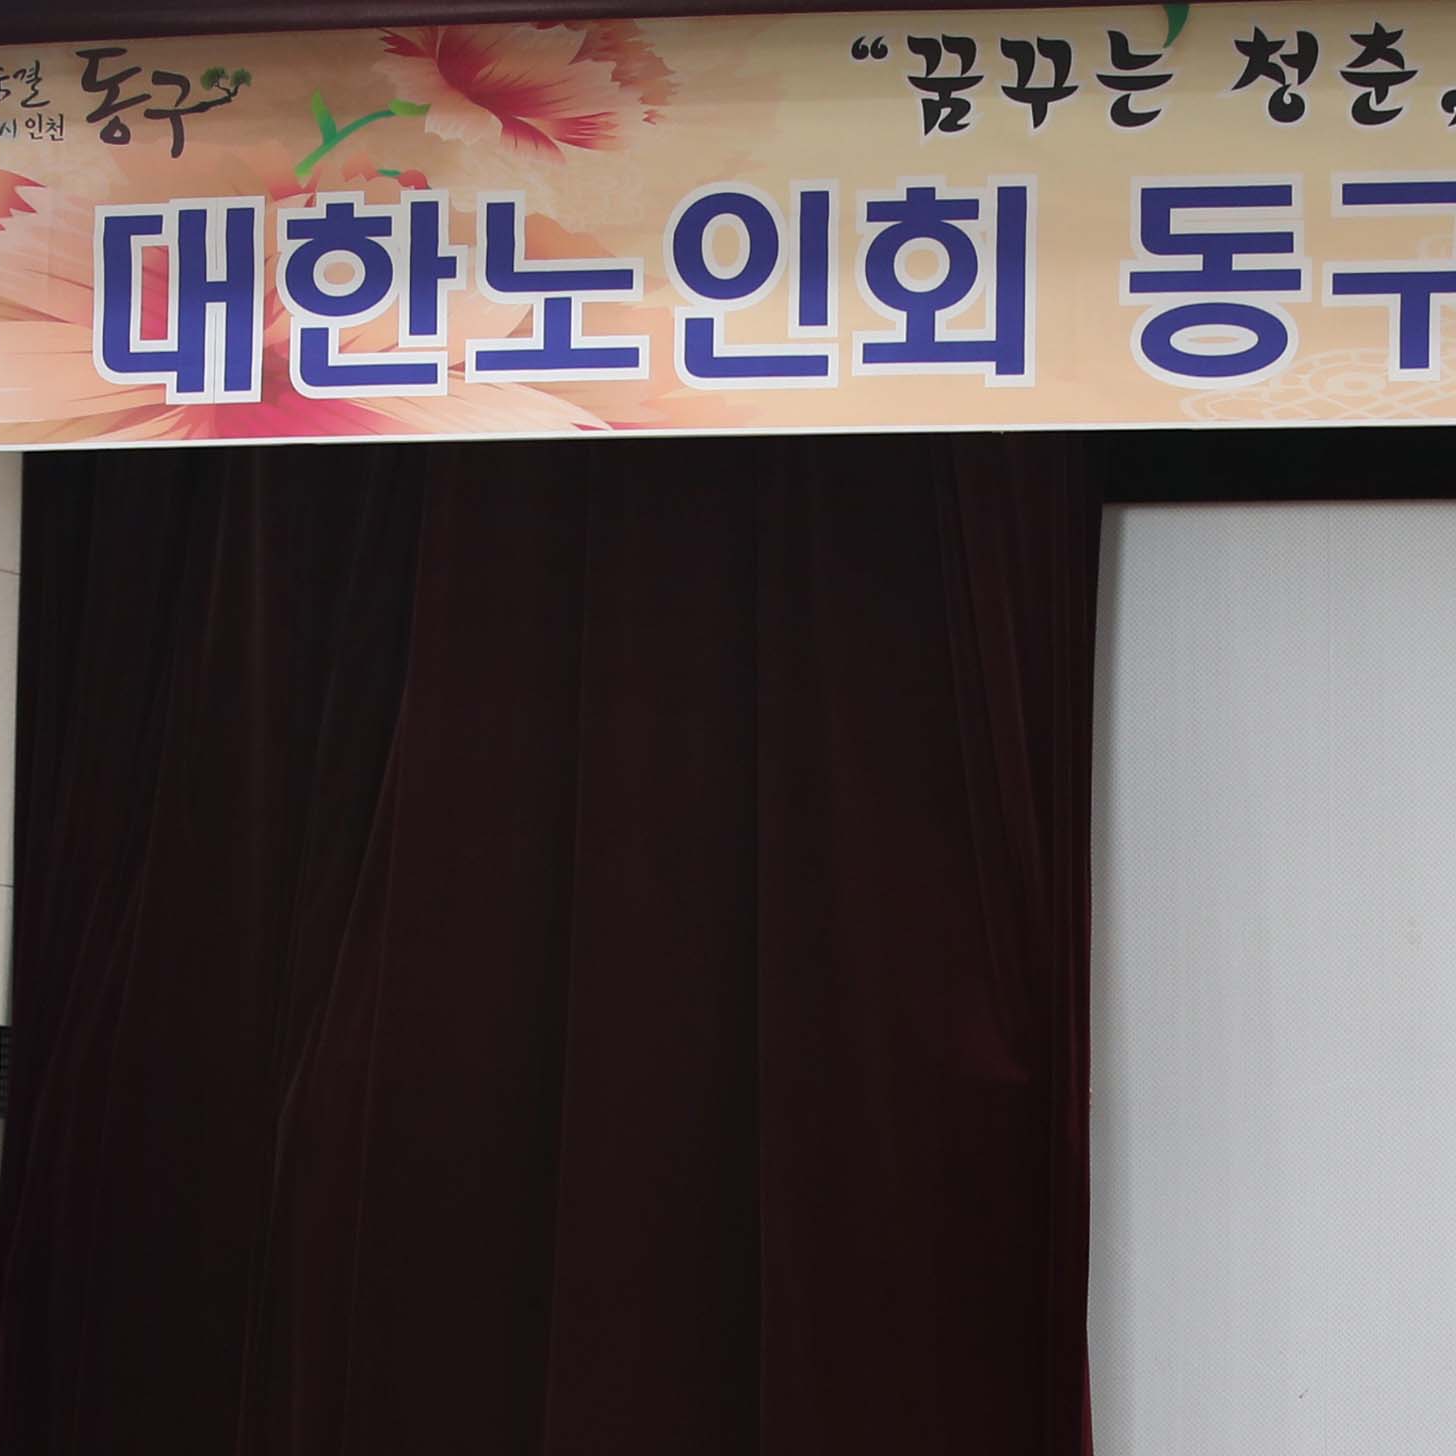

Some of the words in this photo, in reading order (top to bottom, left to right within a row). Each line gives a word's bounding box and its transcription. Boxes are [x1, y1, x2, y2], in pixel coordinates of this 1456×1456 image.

[25, 113, 64, 143] 인천
[76, 47, 232, 158] 동구
[851, 30, 1174, 136] “꿈꾸는
[102, 186, 1028, 394] 대한노인회
